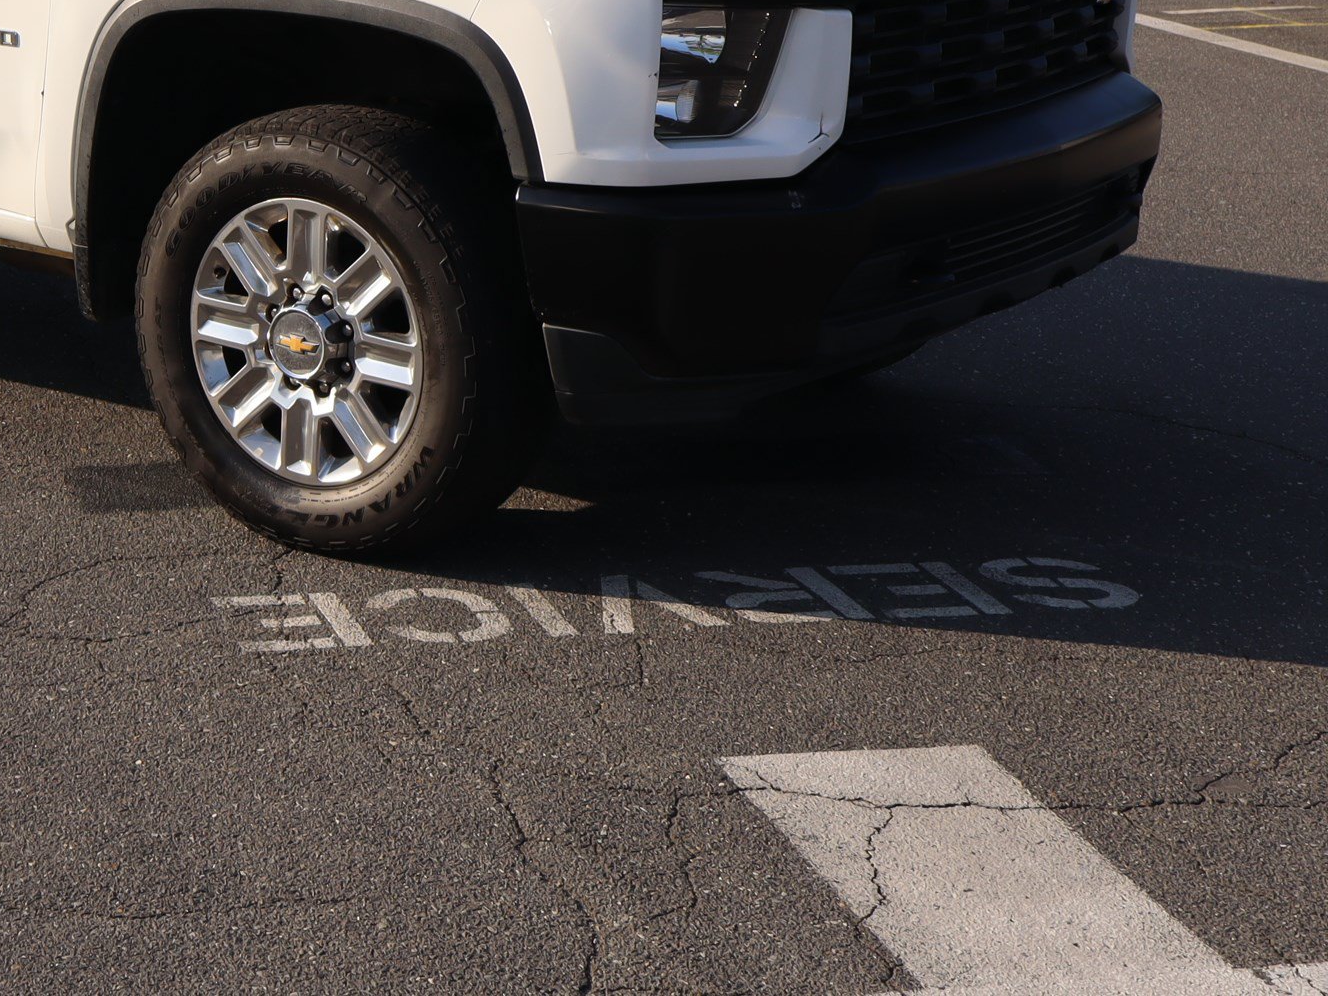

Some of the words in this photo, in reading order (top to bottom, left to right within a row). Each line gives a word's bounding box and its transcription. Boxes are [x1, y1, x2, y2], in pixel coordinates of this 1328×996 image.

[165, 161, 368, 257] GOODYEAR
[255, 445, 436, 528] WRANGL
[210, 556, 1140, 654] SERVICE
